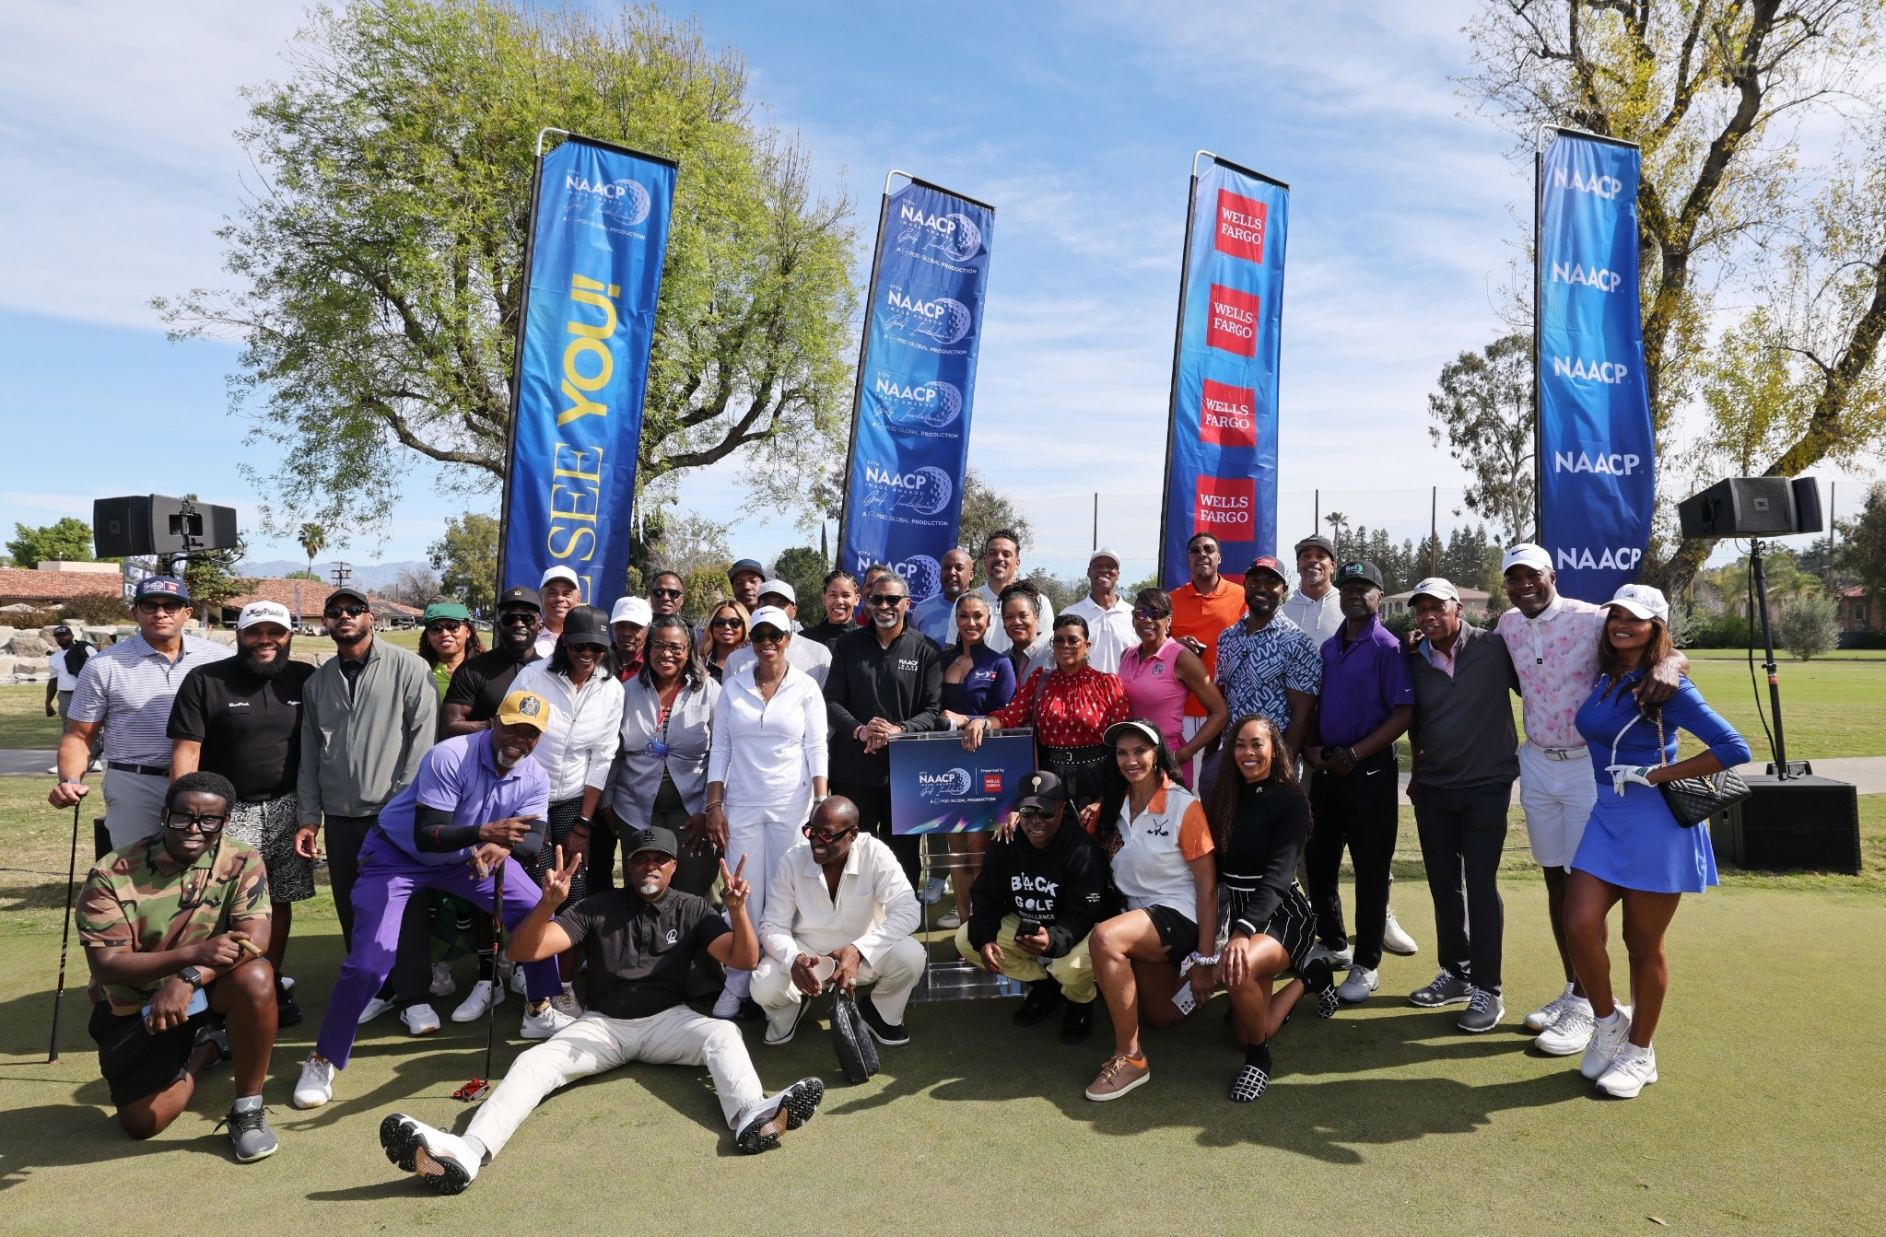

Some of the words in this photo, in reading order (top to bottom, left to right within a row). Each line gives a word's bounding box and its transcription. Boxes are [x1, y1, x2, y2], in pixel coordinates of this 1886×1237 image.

[566, 175, 626, 200] NAACP
[1554, 167, 1623, 200] NAACP
[901, 204, 957, 234] NAACP
[1222, 207, 1262, 230] WELLS
[1221, 223, 1262, 245] FARGO
[941, 262, 977, 274] PRODUCTION
[1552, 260, 1622, 293] NAACP
[888, 289, 945, 319] NAACP
[1213, 302, 1253, 324] WELLS
[1213, 318, 1253, 339] FARGO
[556, 273, 621, 427] YOU!
[930, 347, 967, 355] PRODUCTION
[1553, 355, 1628, 384] NAACP
[876, 377, 936, 402] NAACP
[1206, 398, 1249, 415] WELLS
[1205, 414, 1250, 429] FARGO
[1555, 450, 1640, 476] NAACP
[866, 466, 927, 489] NAACP
[547, 442, 604, 561] SEE
[1200, 494, 1249, 509] WELLS
[911, 518, 949, 526] PRODUCTION
[1200, 510, 1249, 523] FARGO
[1557, 547, 1642, 571] NAACP
[919, 774, 955, 783] NAACP
[1015, 895, 1054, 911] GOLF
